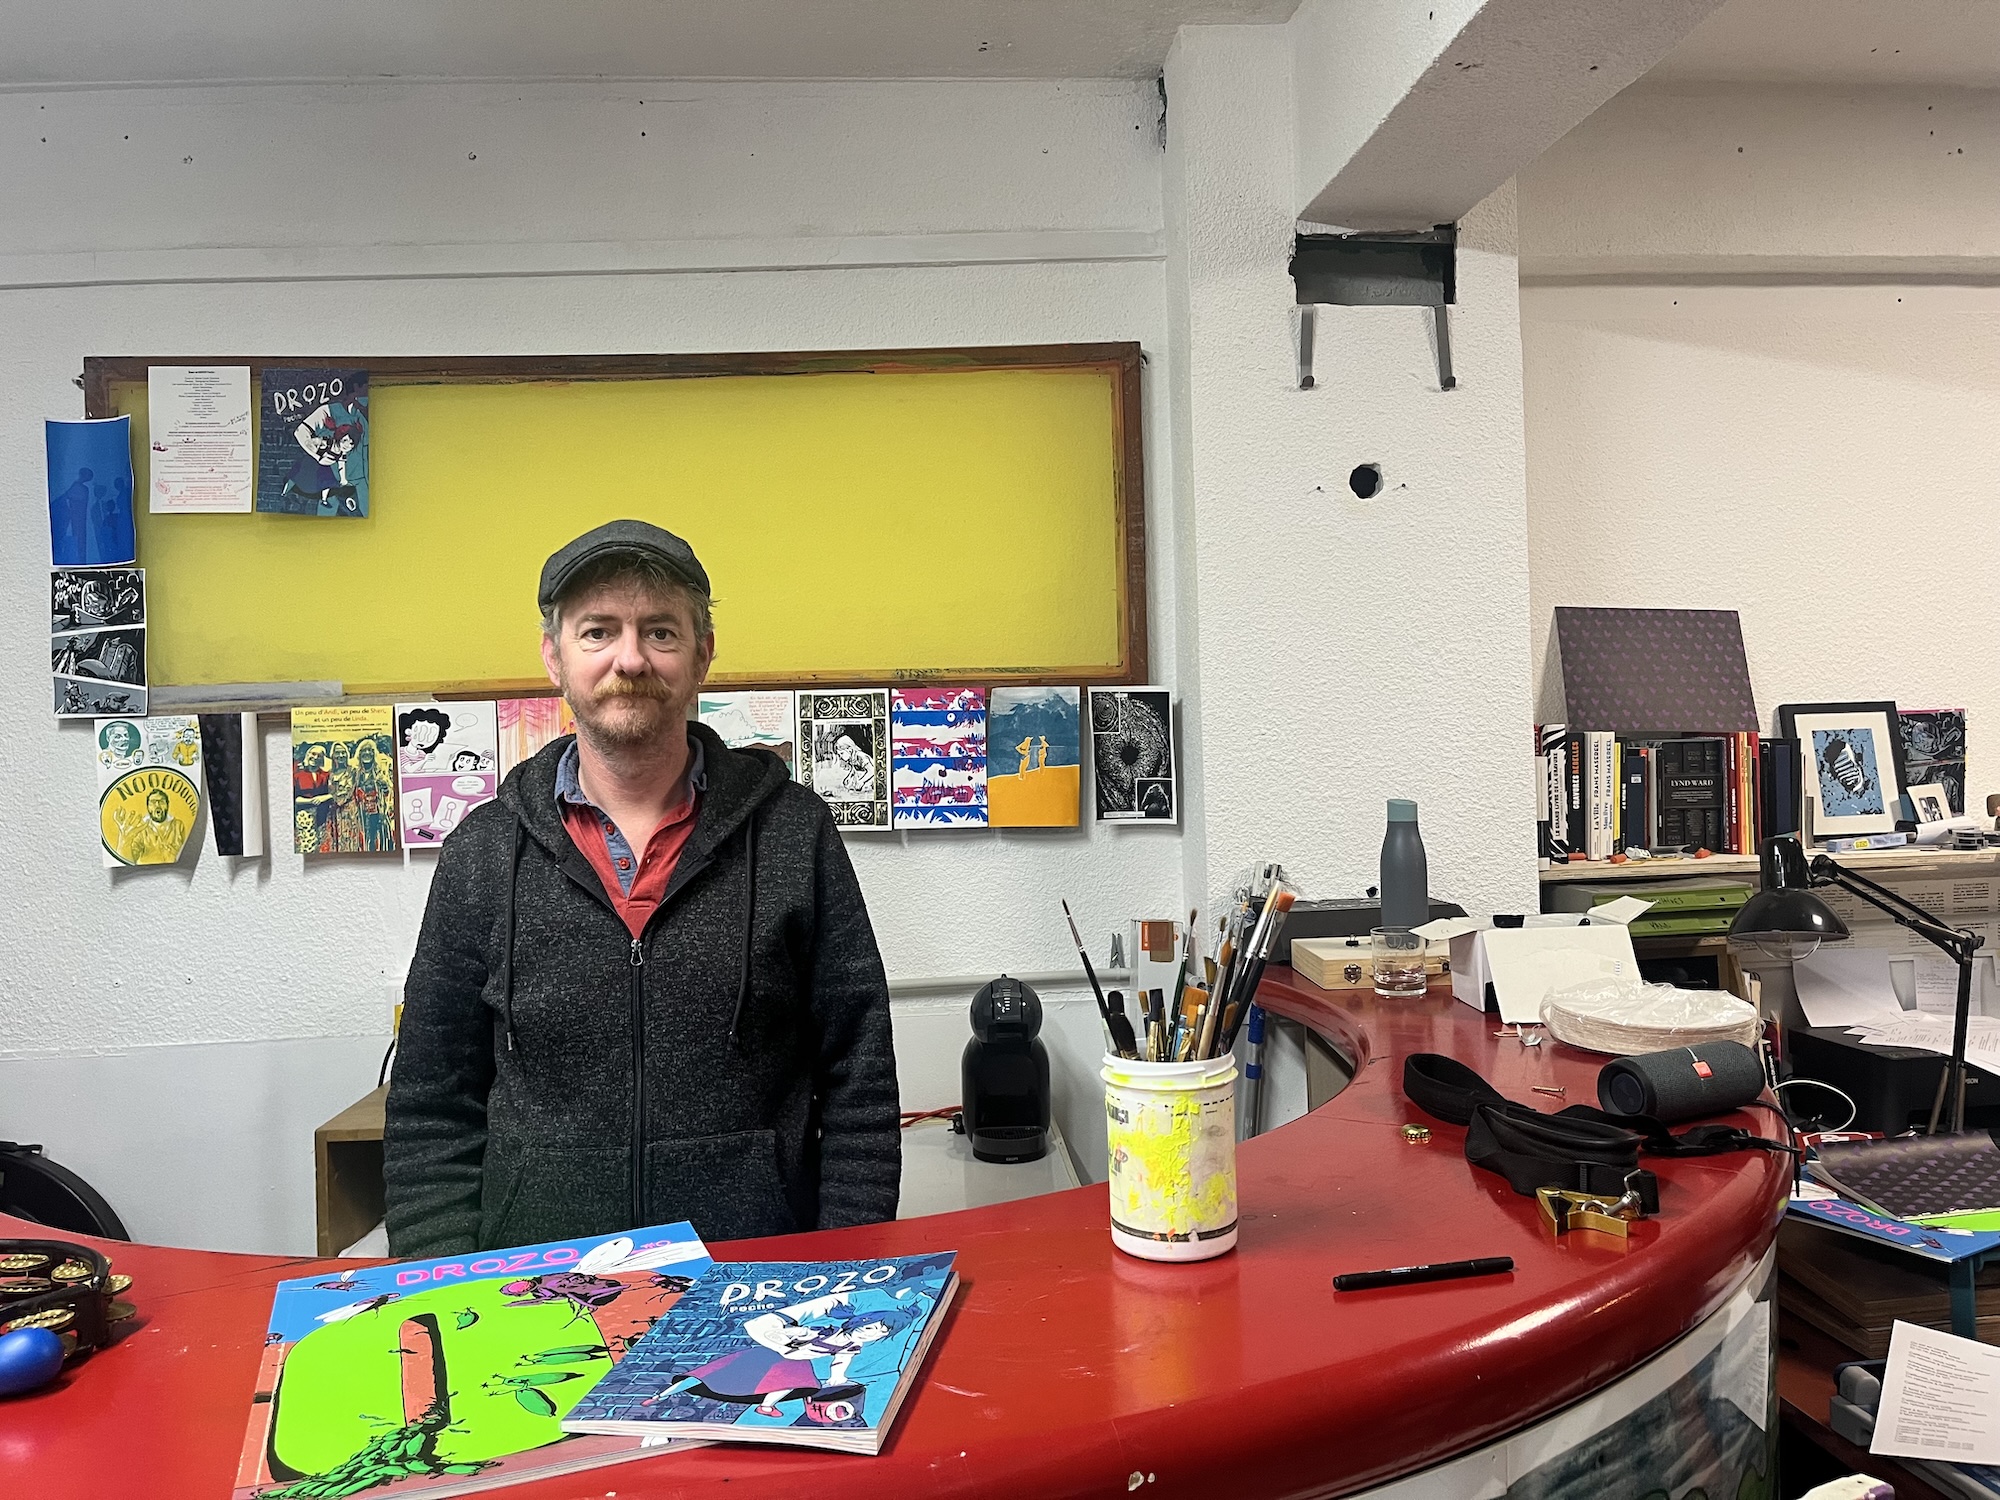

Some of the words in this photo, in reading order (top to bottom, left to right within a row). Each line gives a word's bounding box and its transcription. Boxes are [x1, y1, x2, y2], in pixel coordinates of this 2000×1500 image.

[273, 378, 343, 415] DROZO
[1571, 741, 1580, 774] REBELLES
[1553, 777, 1559, 785] LA
[1554, 785, 1559, 793] DE
[1572, 774, 1580, 810] GRAVURES
[1690, 779, 1714, 787] WARD
[1593, 820, 1600, 831] La
[1807, 1200, 1911, 1236] DROZO
[396, 1248, 583, 1286] DROZO
[719, 1266, 897, 1309] DROZO
[729, 1302, 775, 1314] Poche
